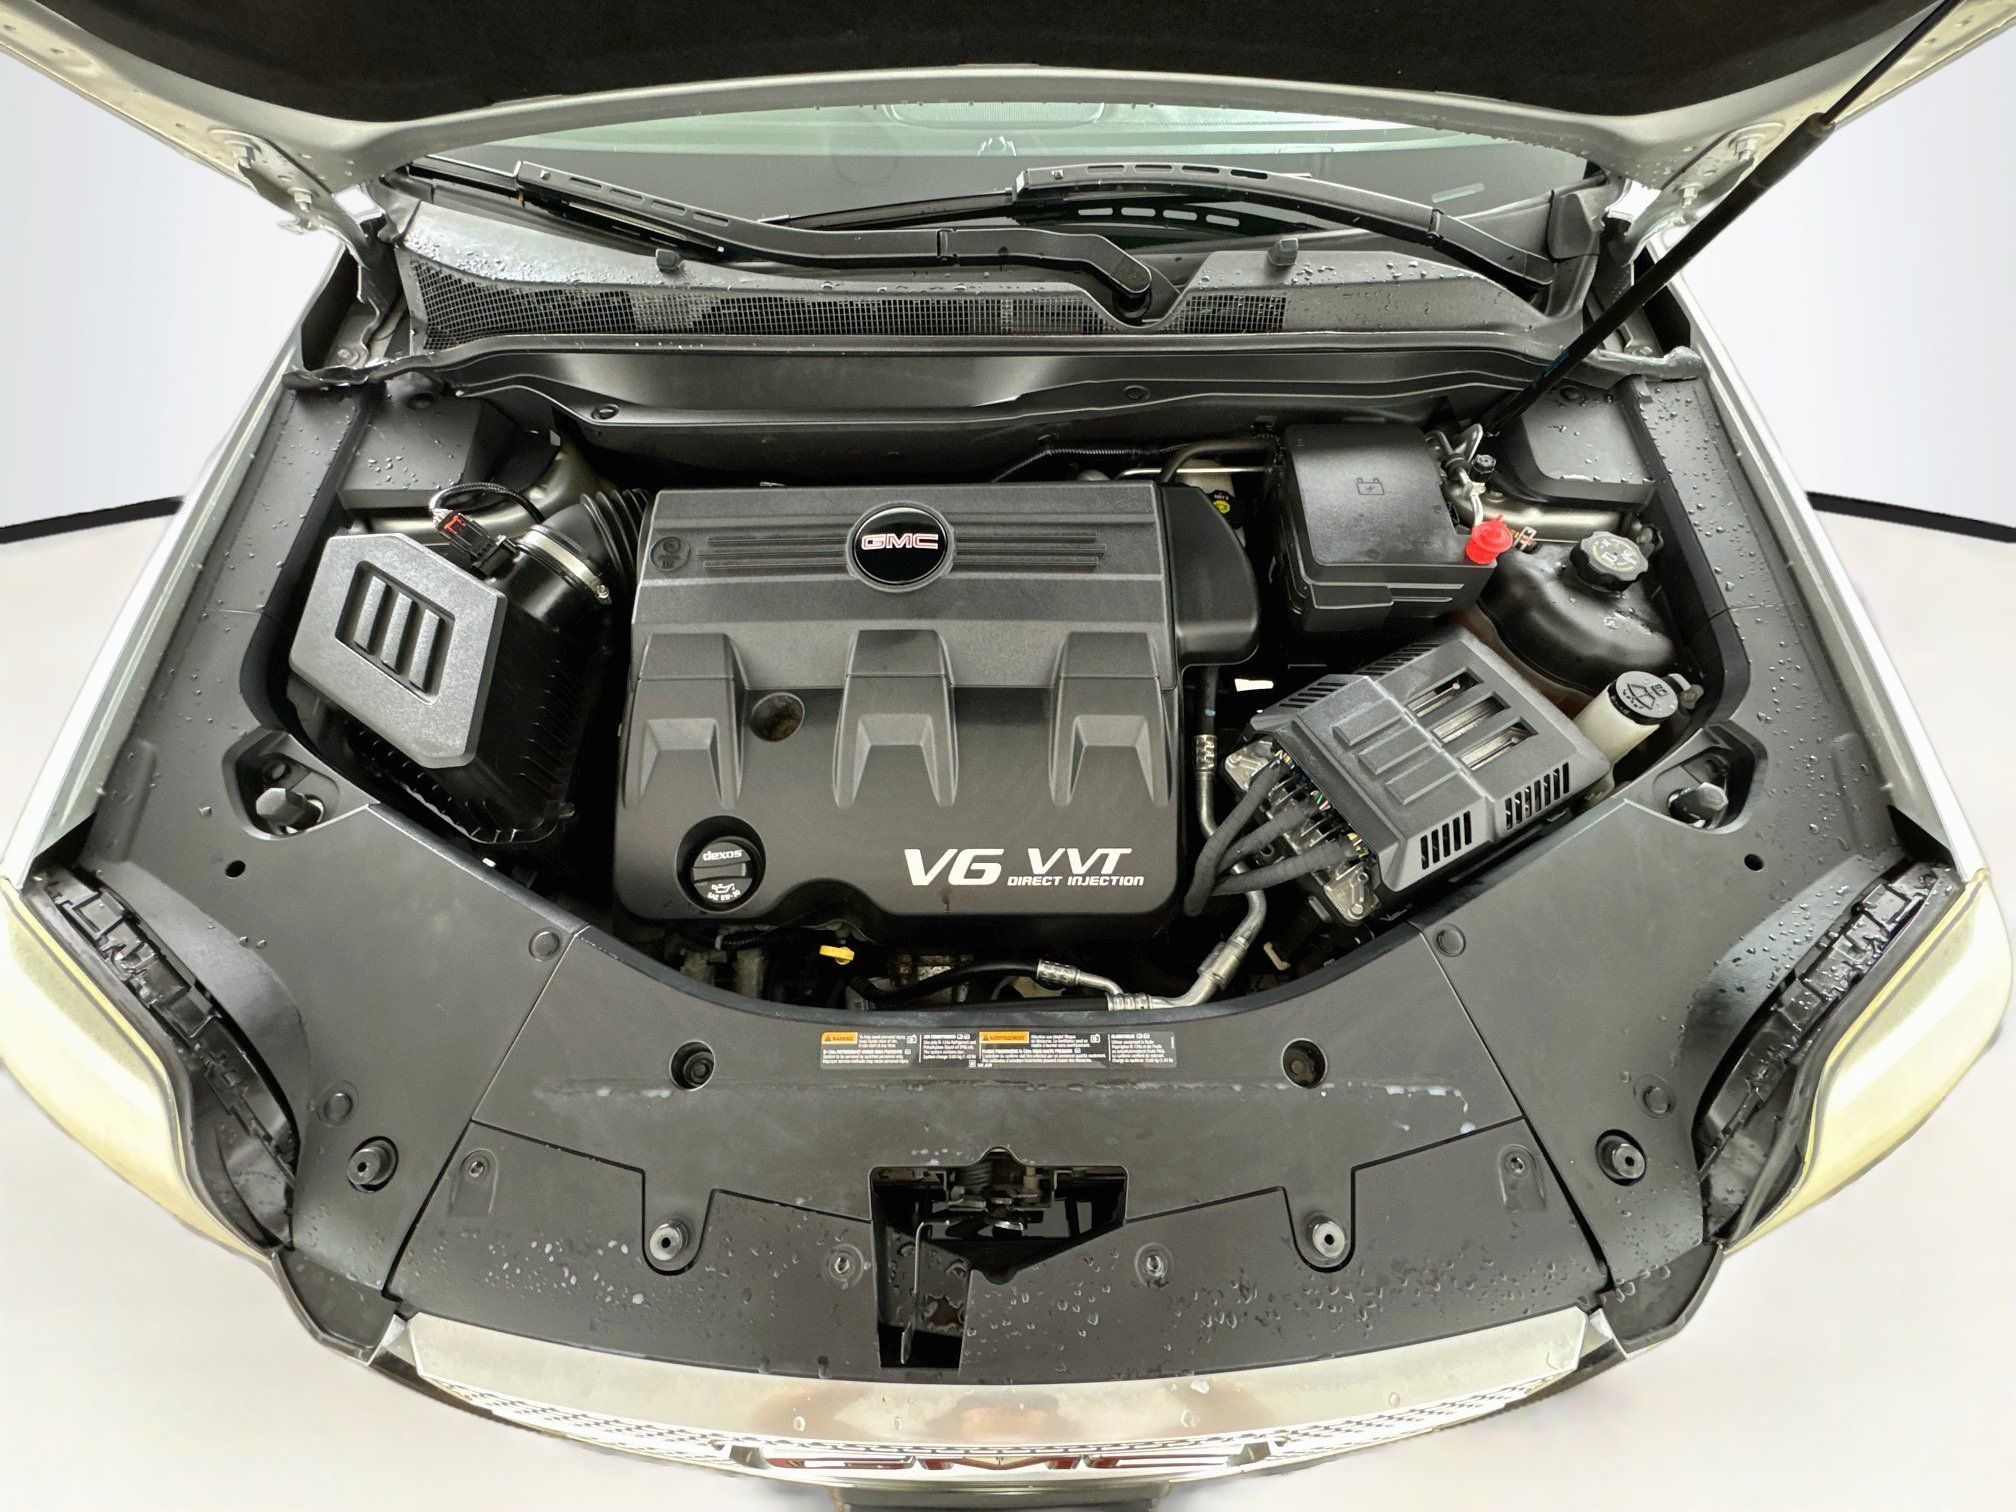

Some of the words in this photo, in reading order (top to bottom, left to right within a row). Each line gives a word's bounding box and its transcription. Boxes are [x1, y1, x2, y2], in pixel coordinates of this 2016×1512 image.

[861, 533, 939, 550] GMC
[703, 849, 743, 861] dexos
[904, 848, 1005, 886] V6
[1027, 848, 1133, 875] VVT
[1007, 876, 1063, 886] DIRECT
[1067, 875, 1145, 886] INJECTION
[707, 892, 720, 901] SAE
